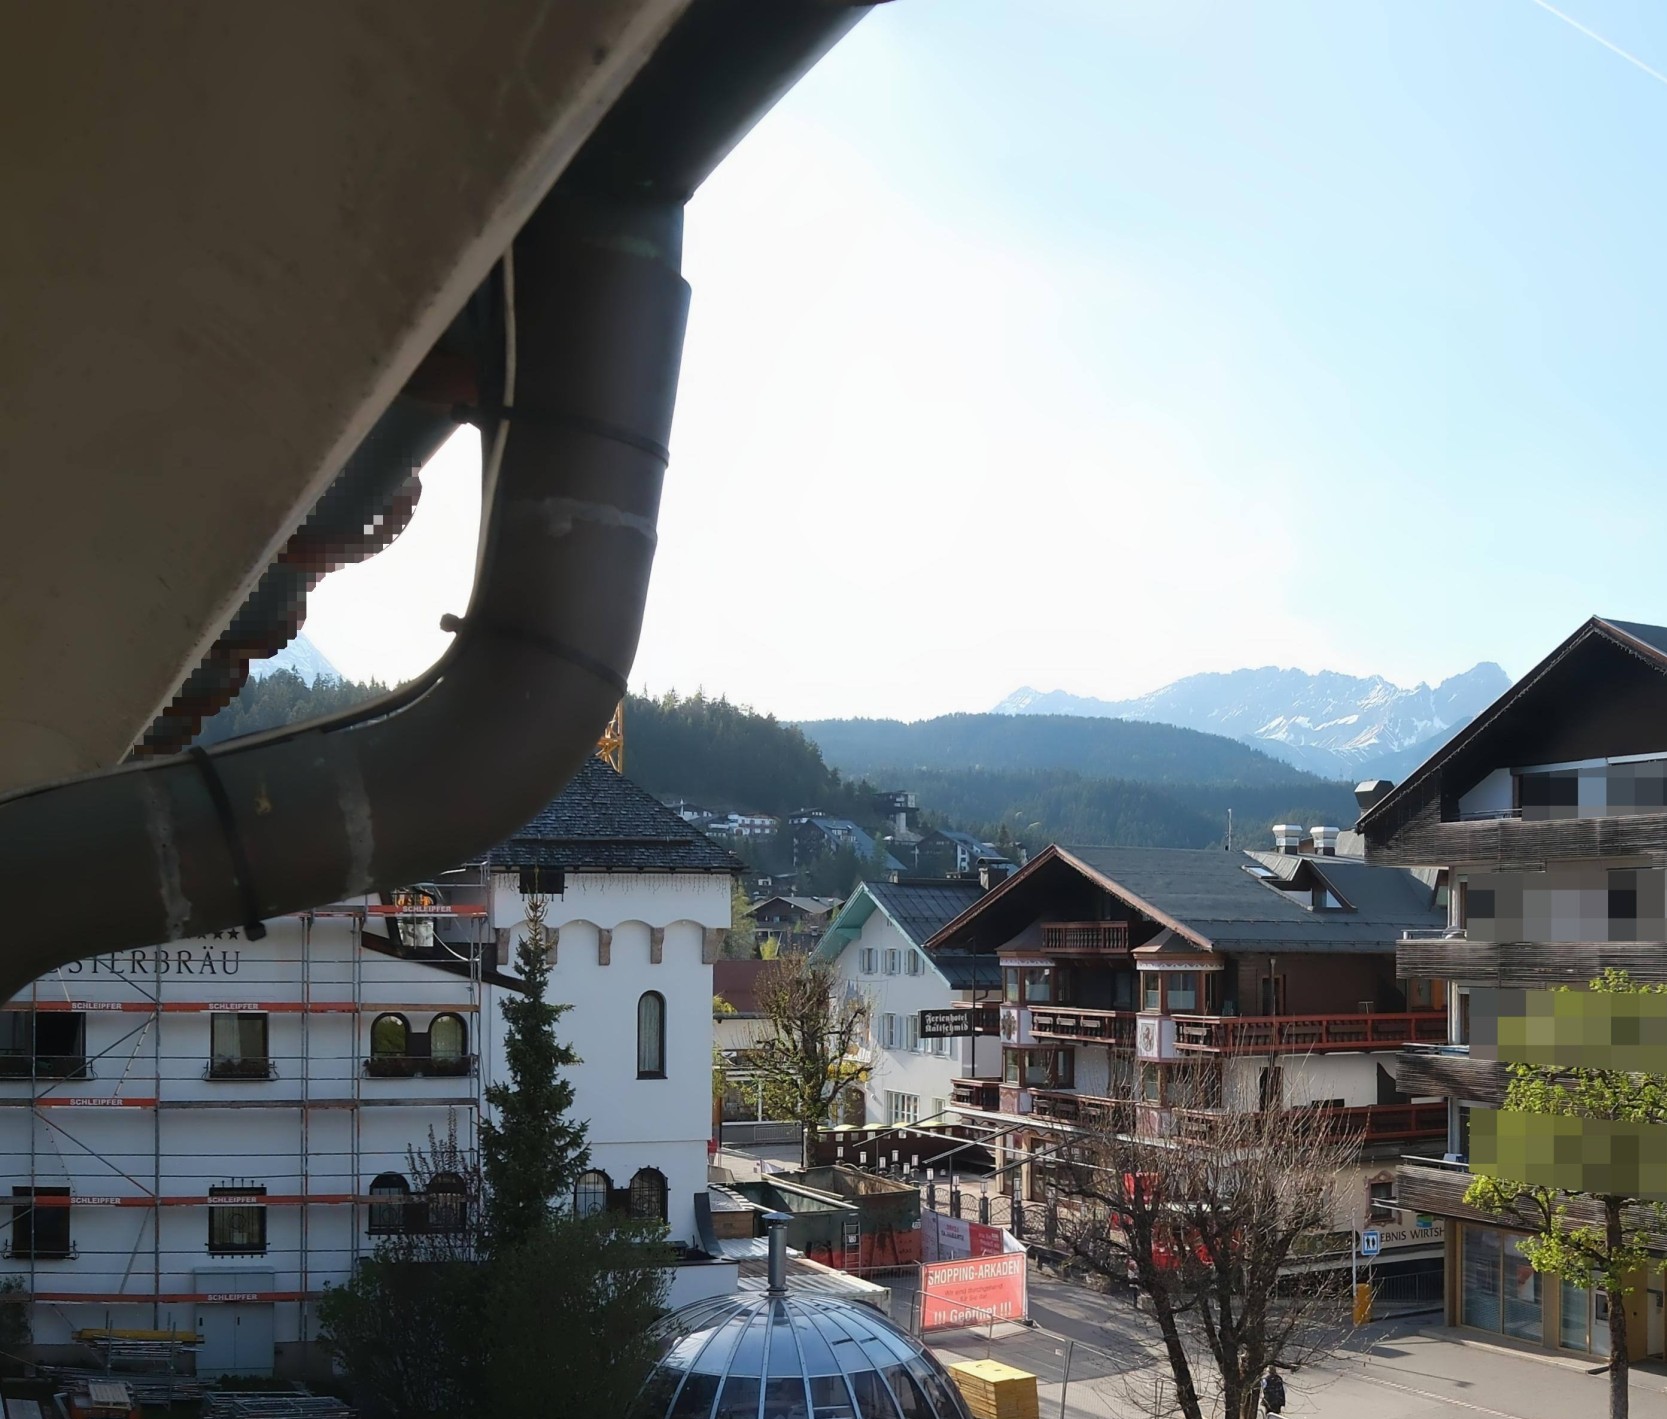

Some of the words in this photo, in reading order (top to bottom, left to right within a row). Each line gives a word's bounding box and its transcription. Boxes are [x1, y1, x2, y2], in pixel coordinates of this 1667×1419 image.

[402, 905, 452, 913] SCHLEIPFER
[47, 945, 241, 975] STERBRÄU
[71, 1002, 122, 1010] SCHLEIPFER
[208, 1002, 259, 1010] SCHLEIPFER
[70, 1098, 123, 1106] SCHLEIPFER
[70, 1197, 121, 1205] SCHLEIPFER
[928, 1260, 1020, 1286] SHOPPING-ARKADEN
[207, 1293, 258, 1301] SCHLEIPFER
